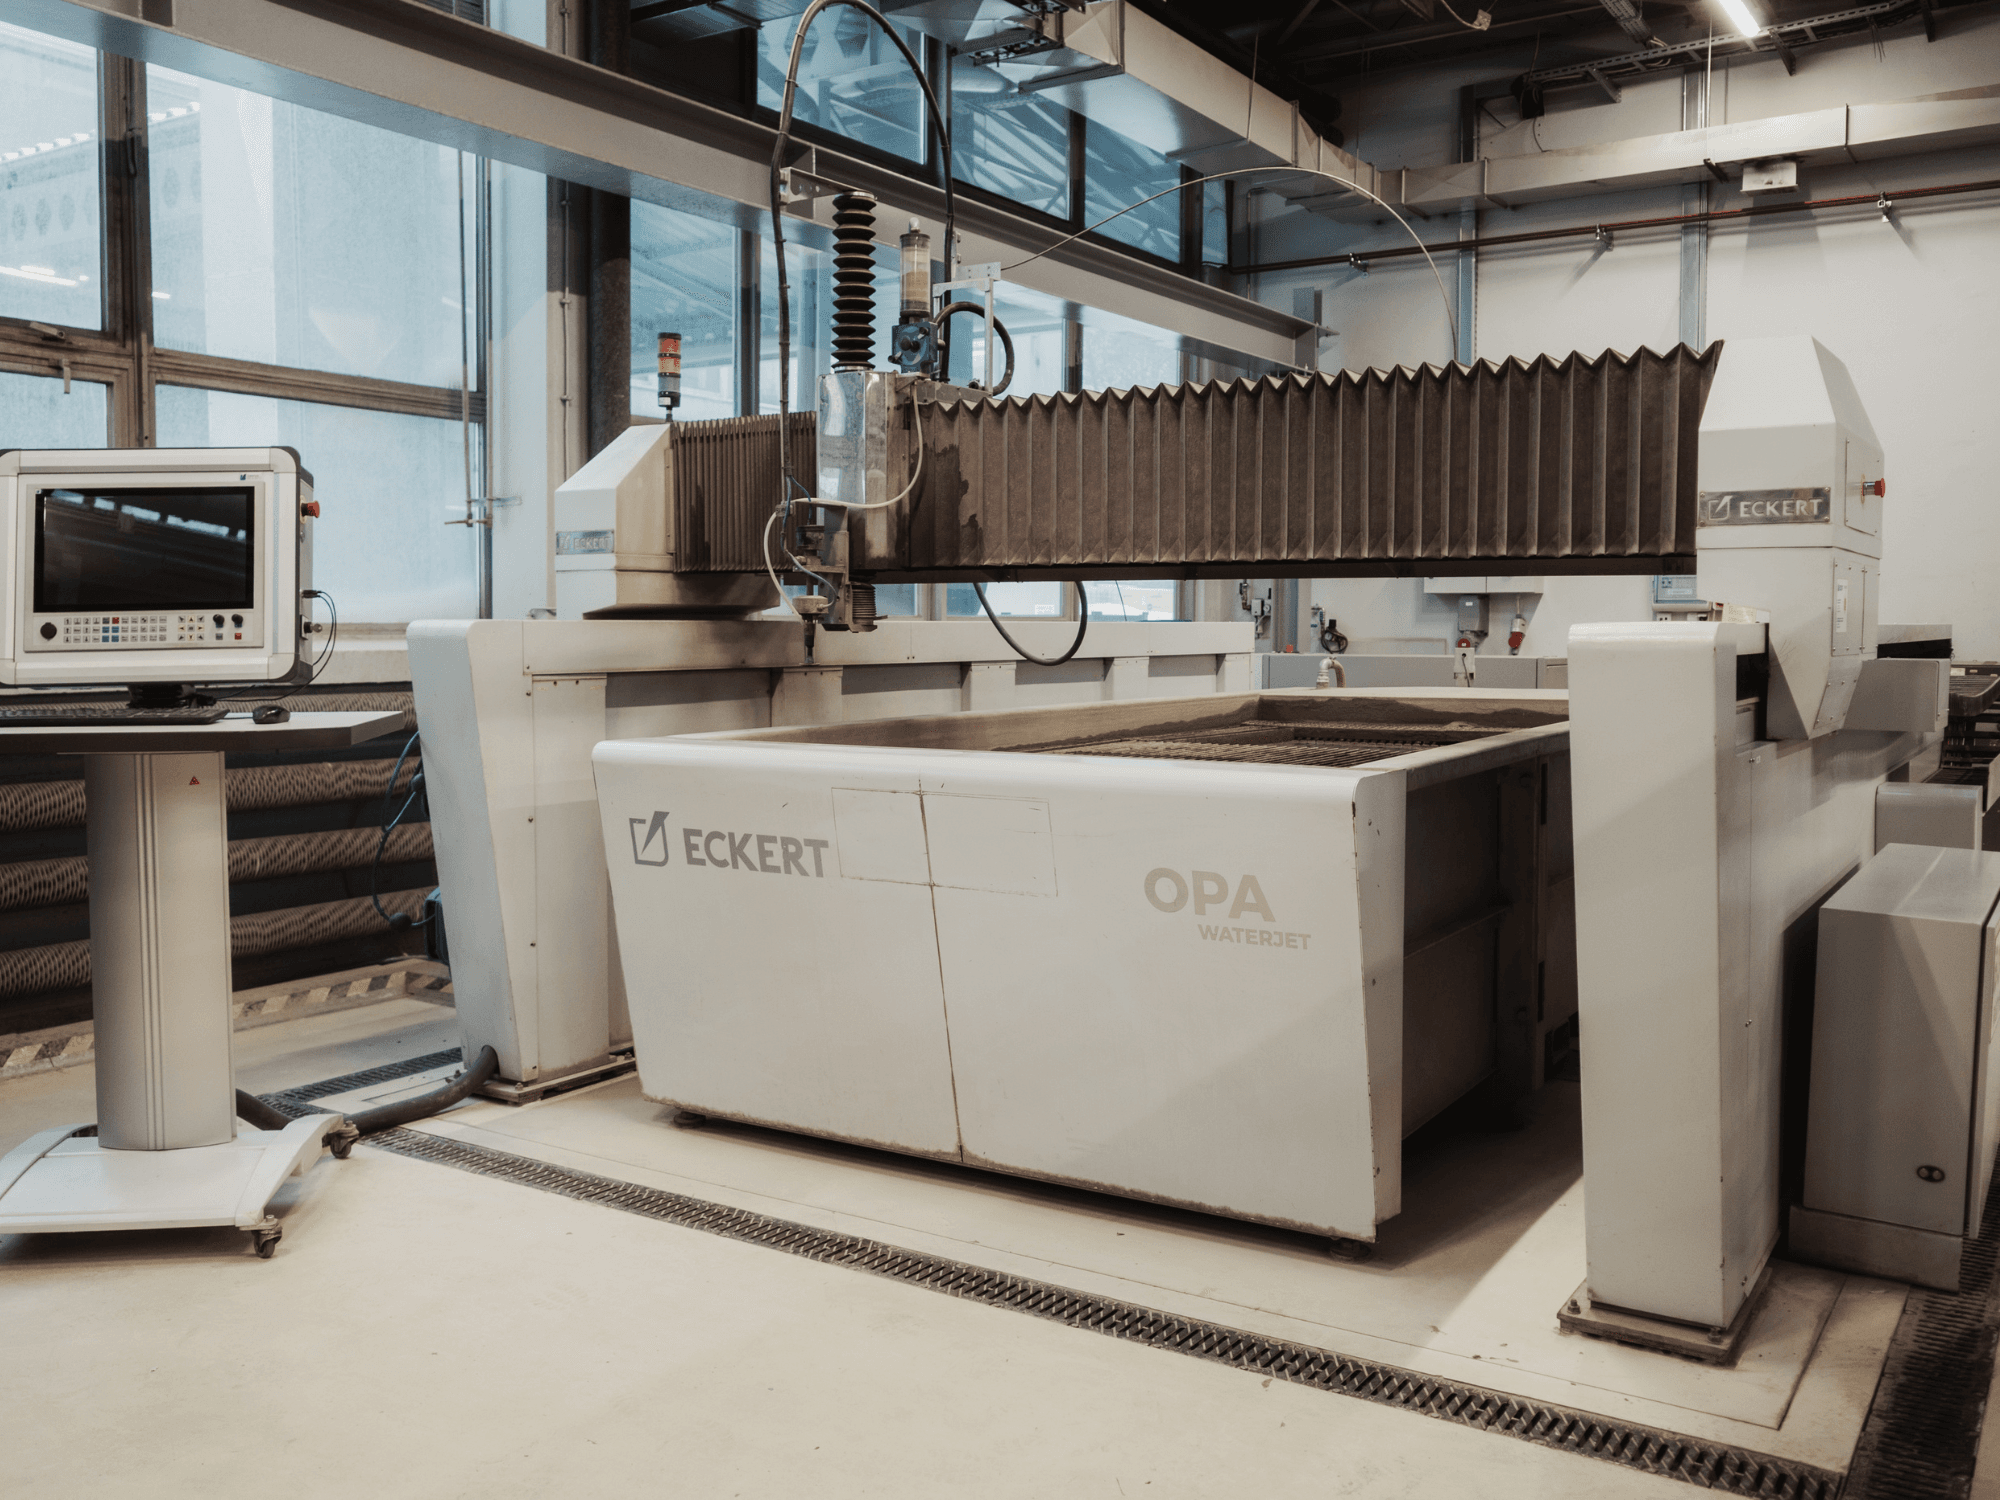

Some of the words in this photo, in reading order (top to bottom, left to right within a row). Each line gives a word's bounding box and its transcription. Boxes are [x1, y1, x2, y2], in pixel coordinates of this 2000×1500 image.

[1740, 499, 1823, 517] ECKERT
[574, 537, 611, 549] ECKERT
[682, 828, 829, 878] ECKERT
[1144, 867, 1276, 922] OPA
[1197, 924, 1311, 950] WATERJET
